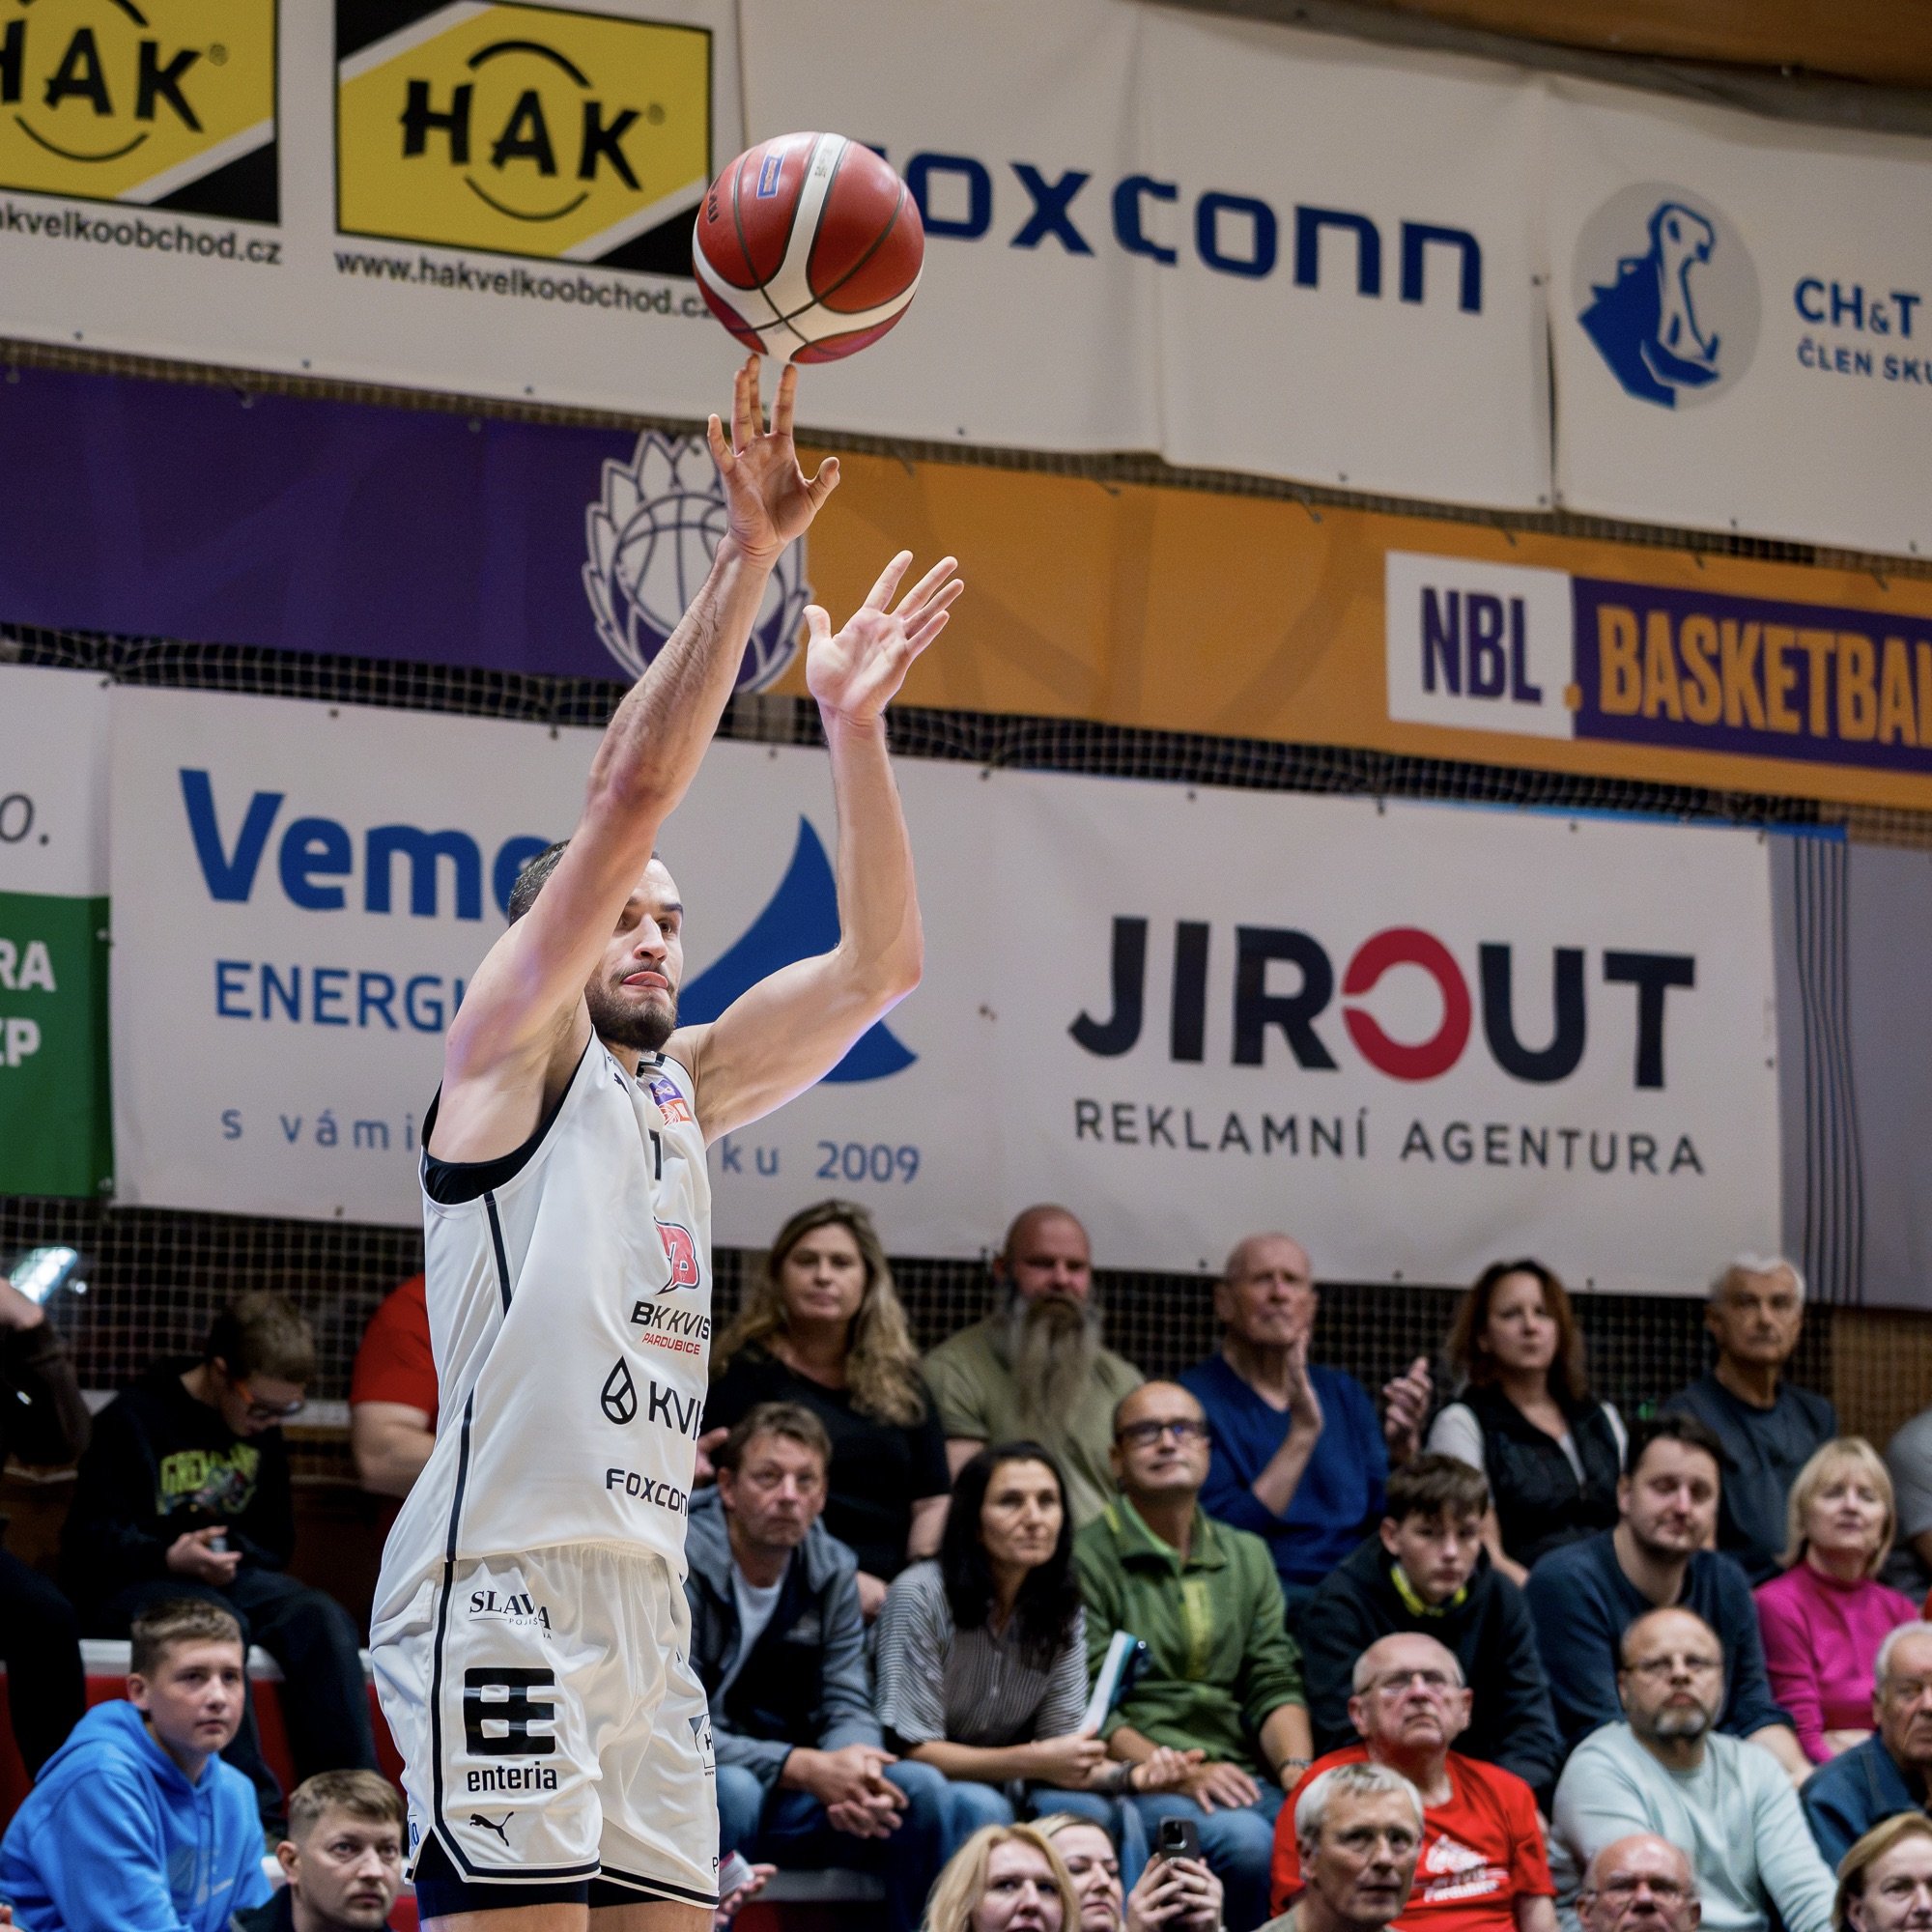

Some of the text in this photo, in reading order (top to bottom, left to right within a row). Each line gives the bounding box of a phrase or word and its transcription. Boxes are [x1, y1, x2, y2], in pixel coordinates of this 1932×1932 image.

[401, 79, 640, 191] HAK
[1794, 276, 1921, 338] CH&T
[1797, 336, 1872, 378] ČLEN
[1067, 915, 1697, 1091] JIROUT
[815, 1140, 922, 1184] 2009
[1074, 1098, 1704, 1175] REKLAMNÍ AGENTURA
[641, 1332, 701, 1355] PARDUBICE
[648, 1379, 703, 1441] KVI
[467, 1760, 558, 1792] enteria
